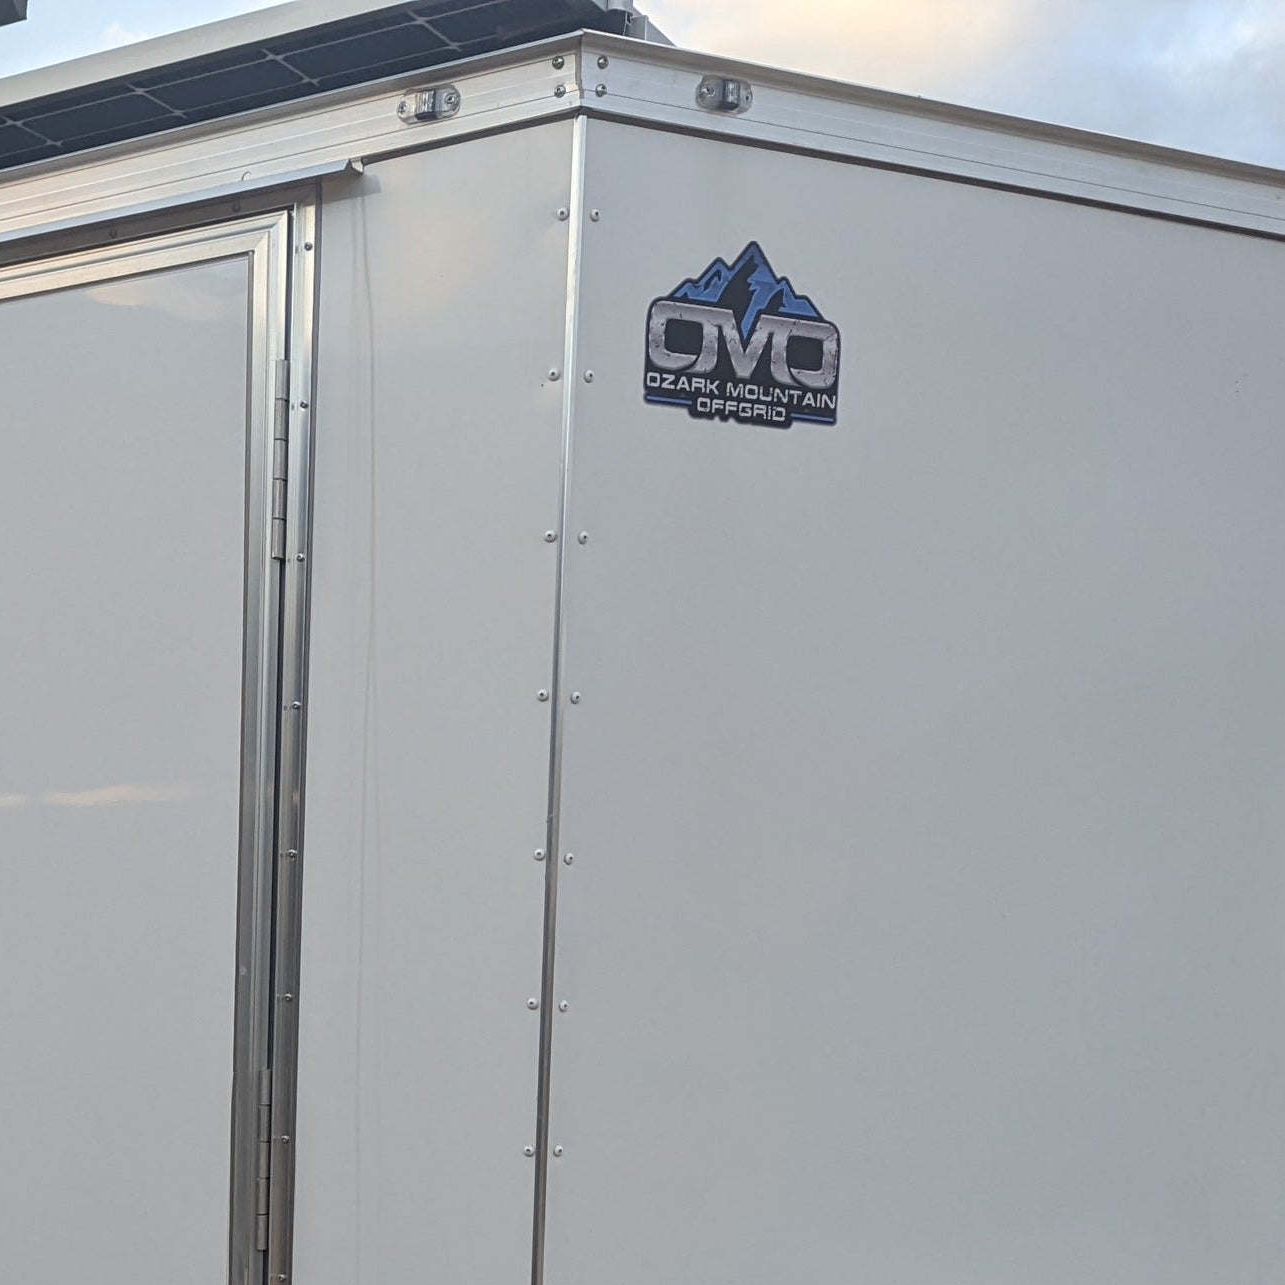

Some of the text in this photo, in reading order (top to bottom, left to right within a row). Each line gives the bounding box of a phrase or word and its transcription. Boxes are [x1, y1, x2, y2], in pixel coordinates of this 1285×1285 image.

[646, 372, 836, 409] OZARK MOUNTAIN
[697, 397, 786, 421] OFFGRID
